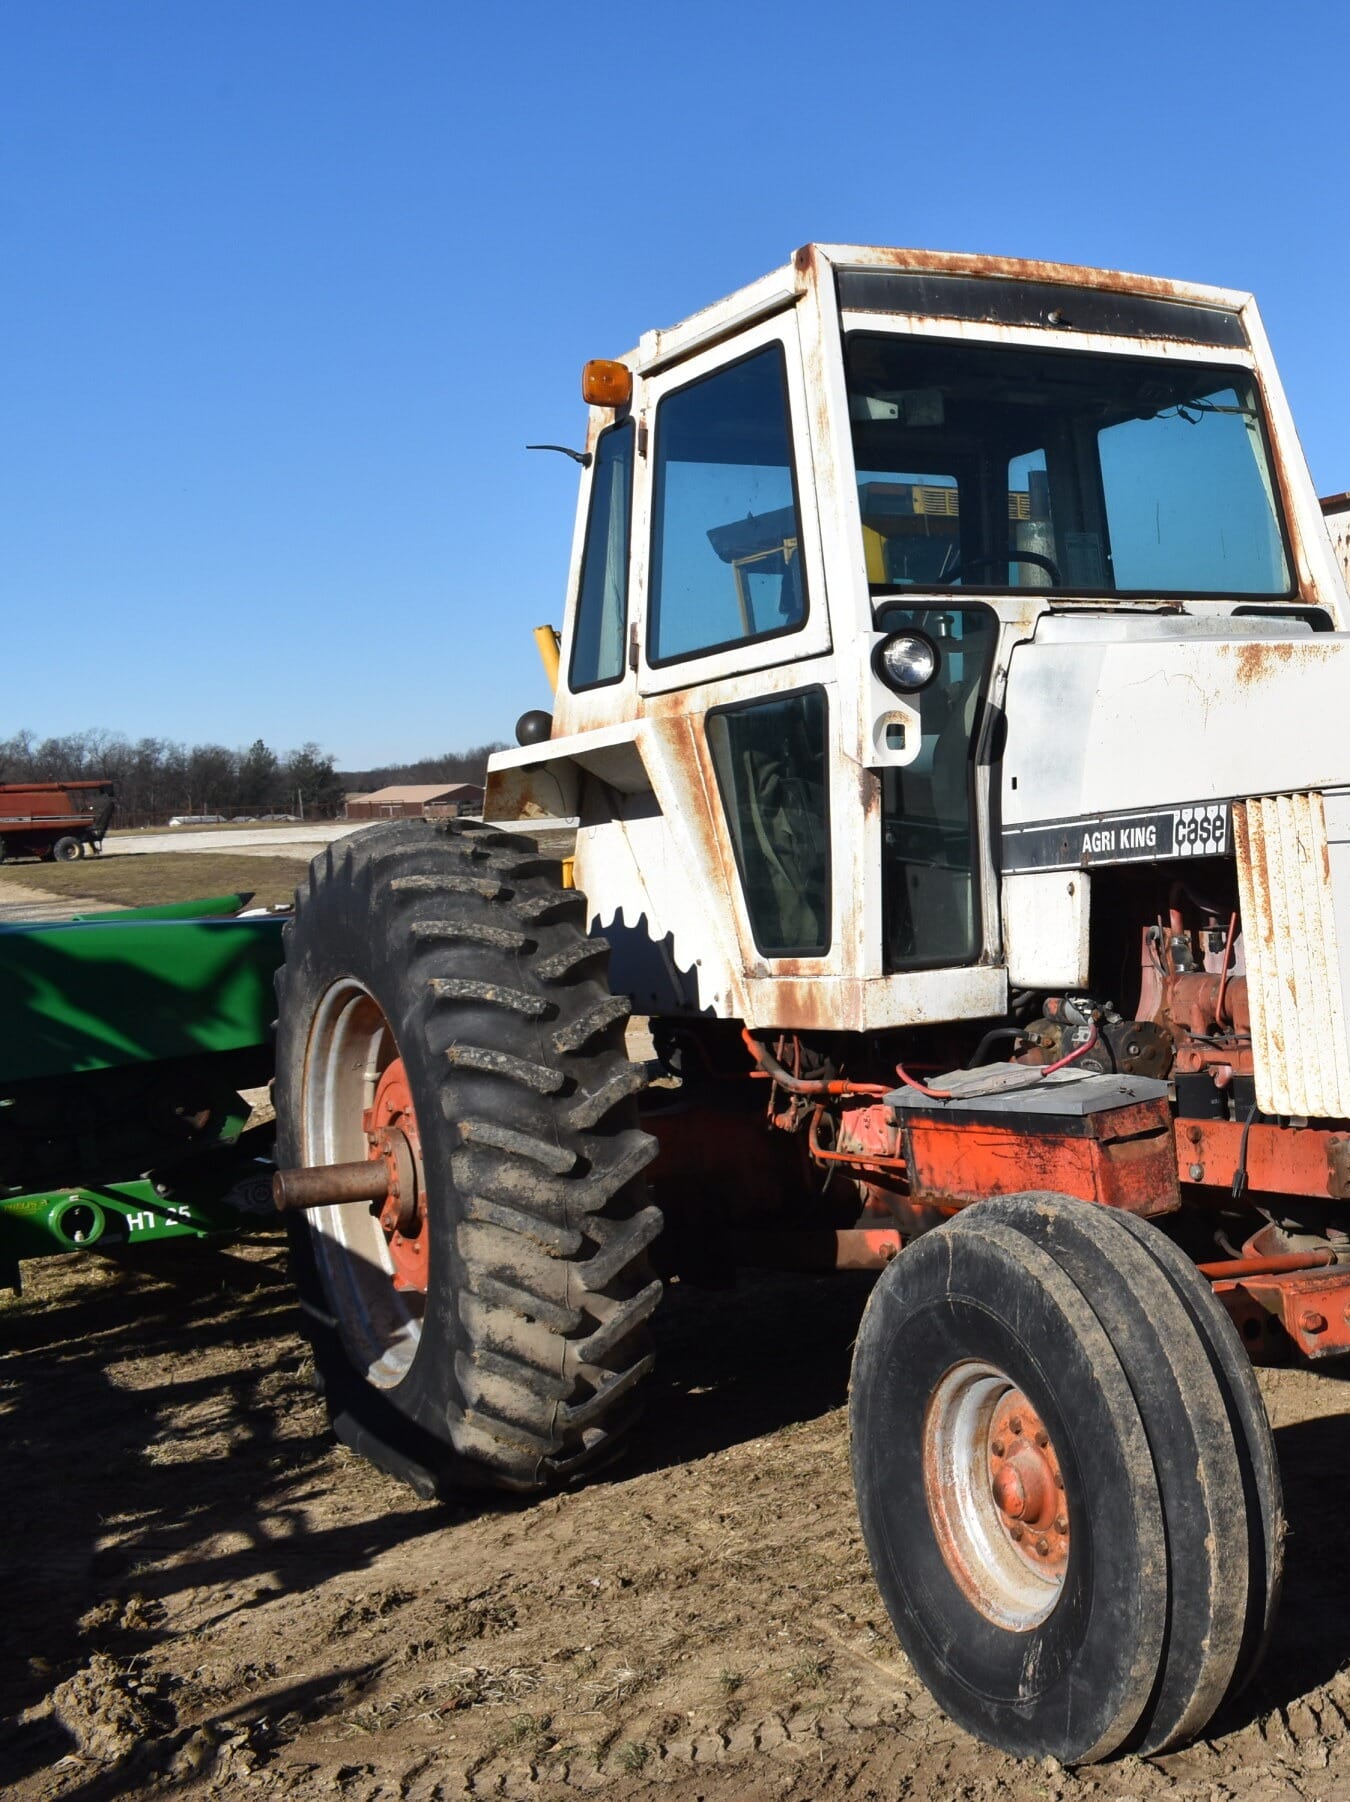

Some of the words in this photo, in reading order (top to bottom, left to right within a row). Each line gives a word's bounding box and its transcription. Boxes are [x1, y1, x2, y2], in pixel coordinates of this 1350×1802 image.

[1082, 830, 1115, 853] AGRI
[1120, 825, 1156, 849] KING
[126, 1211, 155, 1232] HT
